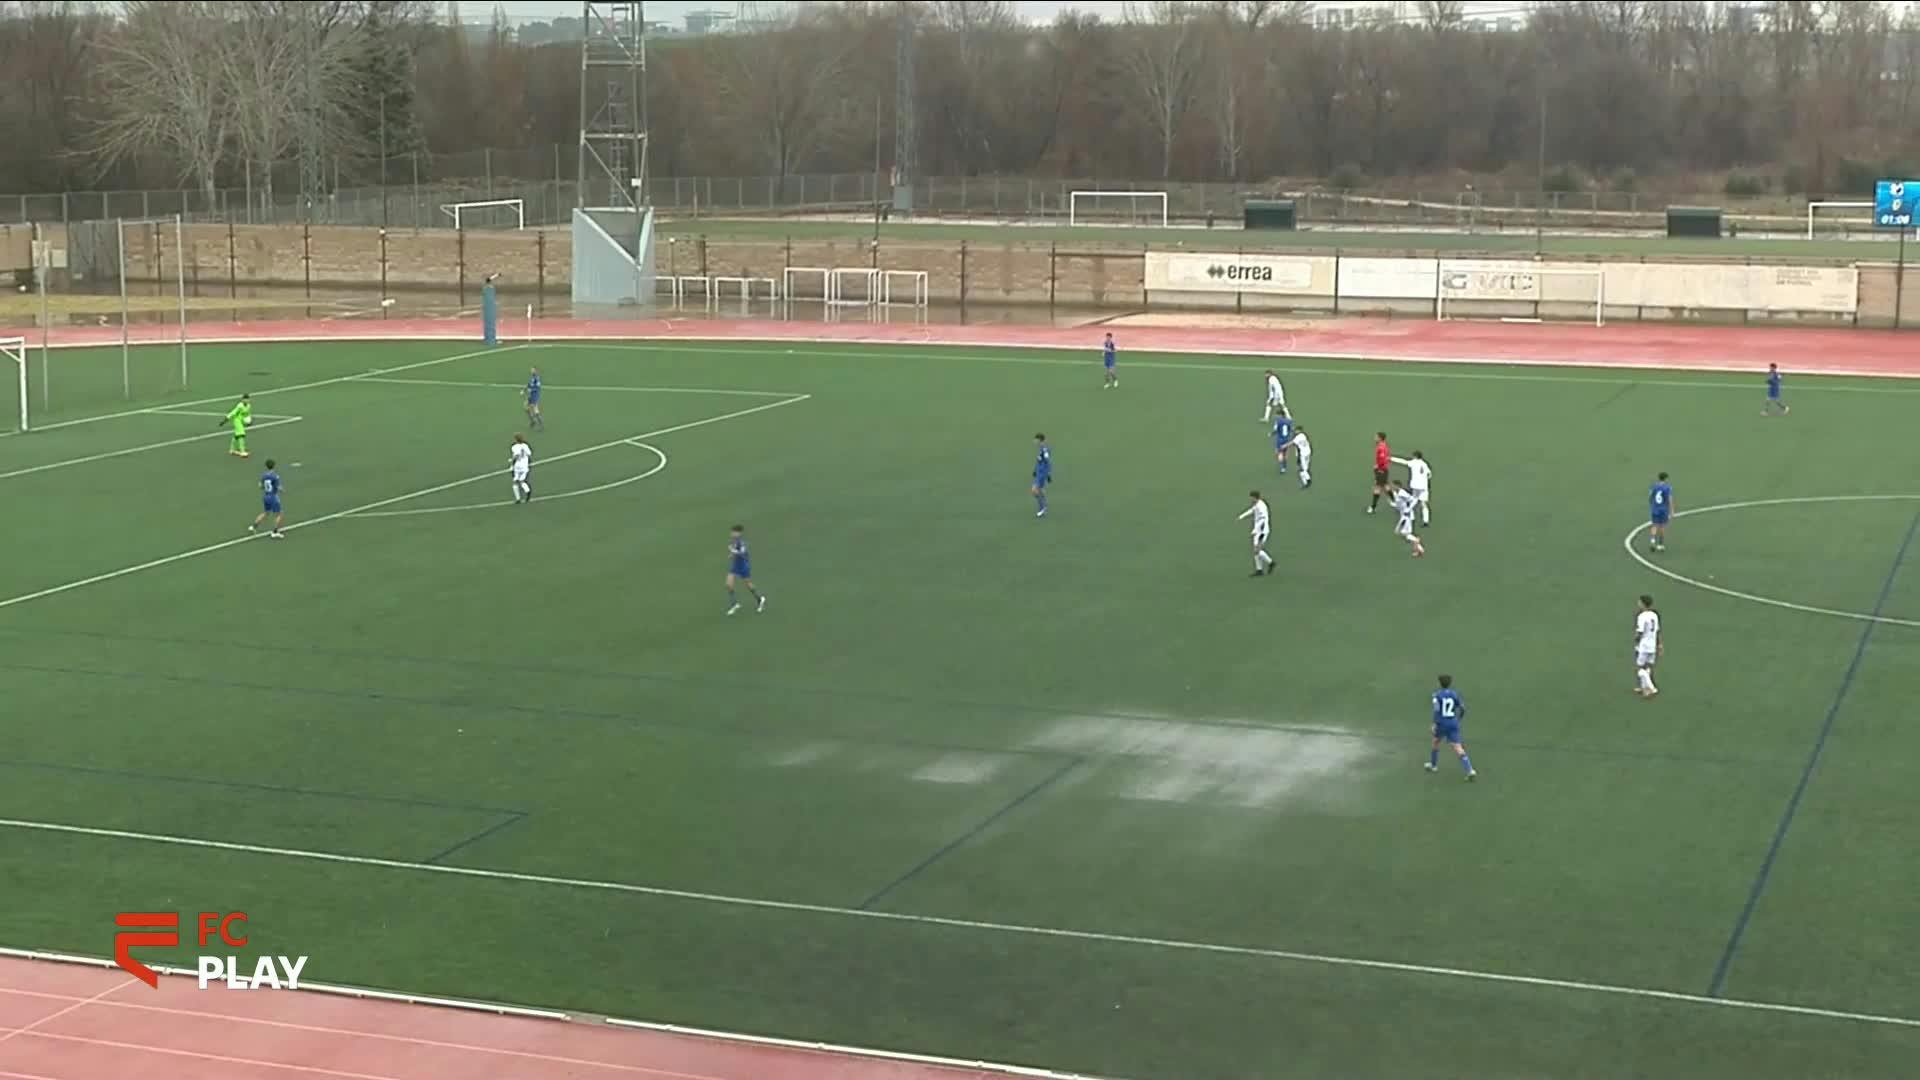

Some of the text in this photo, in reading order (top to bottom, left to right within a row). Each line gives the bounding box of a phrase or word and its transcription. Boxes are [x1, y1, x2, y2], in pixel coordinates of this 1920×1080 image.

[1227, 264, 1273, 281] errea
[1655, 490, 1663, 504] 6
[1442, 697, 1455, 717] 12
